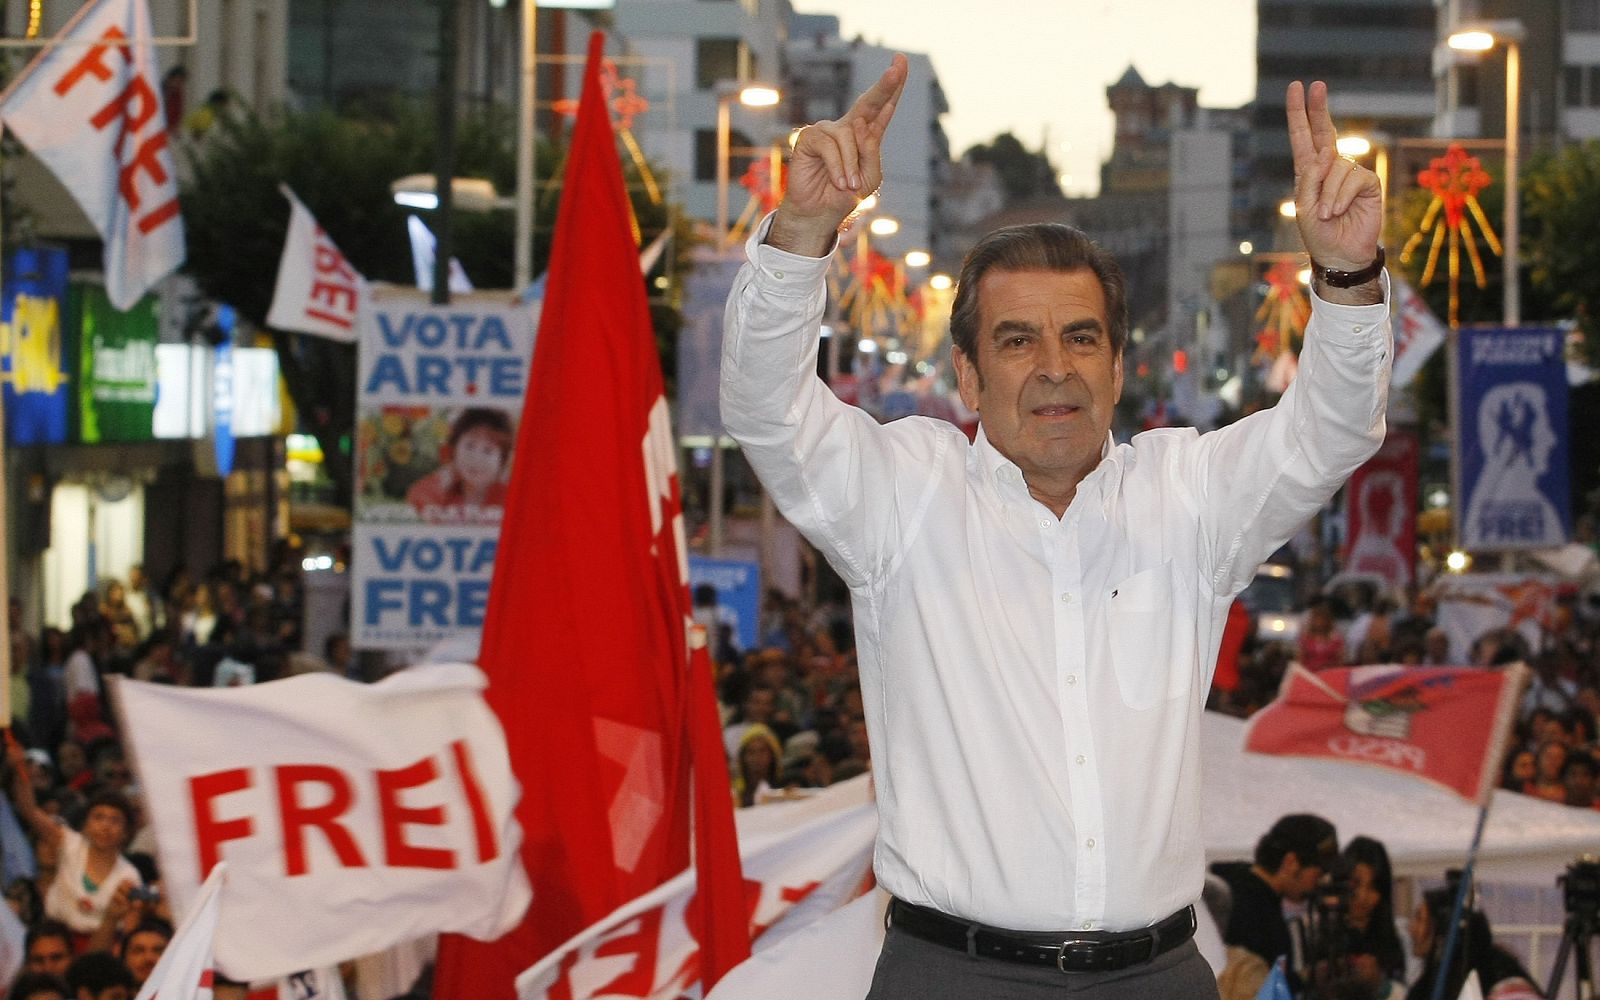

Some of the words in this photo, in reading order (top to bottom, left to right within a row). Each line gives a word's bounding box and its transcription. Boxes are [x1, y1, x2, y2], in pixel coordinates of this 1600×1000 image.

[54, 25, 181, 235] FREI
[376, 312, 513, 350] VOTA
[365, 355, 523, 396] ARTE
[364, 579, 490, 628] FRE
[188, 739, 500, 885] FREI
